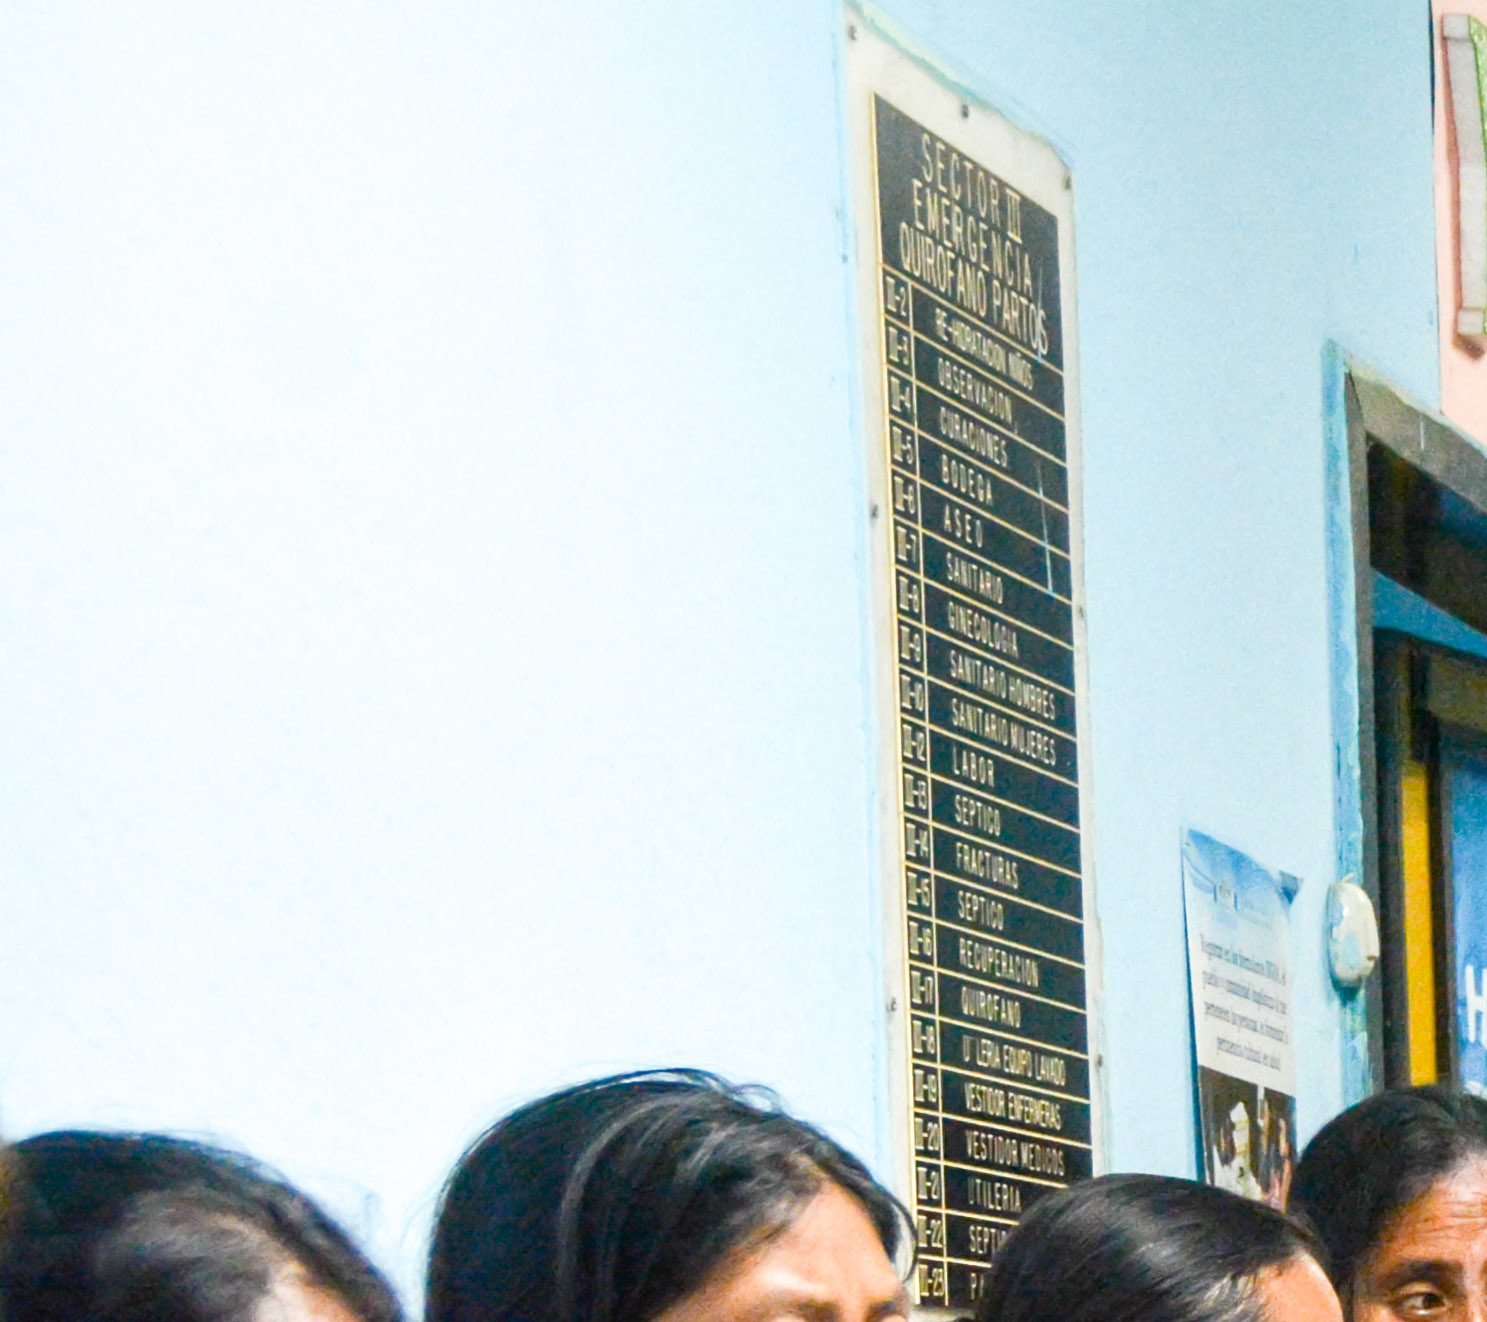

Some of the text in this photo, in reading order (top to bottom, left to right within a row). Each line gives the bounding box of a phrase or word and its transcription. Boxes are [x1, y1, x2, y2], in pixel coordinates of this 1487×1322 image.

[922, 132, 1023, 244] SECTOR III
[911, 178, 1034, 302] EMERGENCIA
[900, 221, 1049, 355] QUIROFANO PARTOS
[938, 356, 1012, 424] OBSERVACION
[940, 405, 1008, 468] CURACIONES
[942, 454, 993, 506] BODEGA
[943, 503, 983, 549] ASEO
[946, 552, 1003, 605] SANITARIO
[948, 600, 1018, 658] GINECOLOGIA
[950, 649, 1006, 699] SANITARIO
[1008, 675, 1055, 719] HOMBRES
[951, 697, 1008, 746] SANITARIO
[1010, 721, 1056, 765] MUJERES
[953, 746, 995, 787] LABOR
[955, 794, 1000, 836] SEPTICO
[956, 843, 1018, 889] FRACTURAS
[958, 890, 1004, 930] SEPTICO
[959, 938, 1039, 986] RECUPERACION
[961, 987, 1021, 1028] QUIROFANO
[965, 1083, 1006, 1117] VESTIDOR
[1008, 1093, 1062, 1130] ENFERMERAS
[966, 1131, 1018, 1166] VESTIDOR
[1020, 1142, 1065, 1176] MEDICOS
